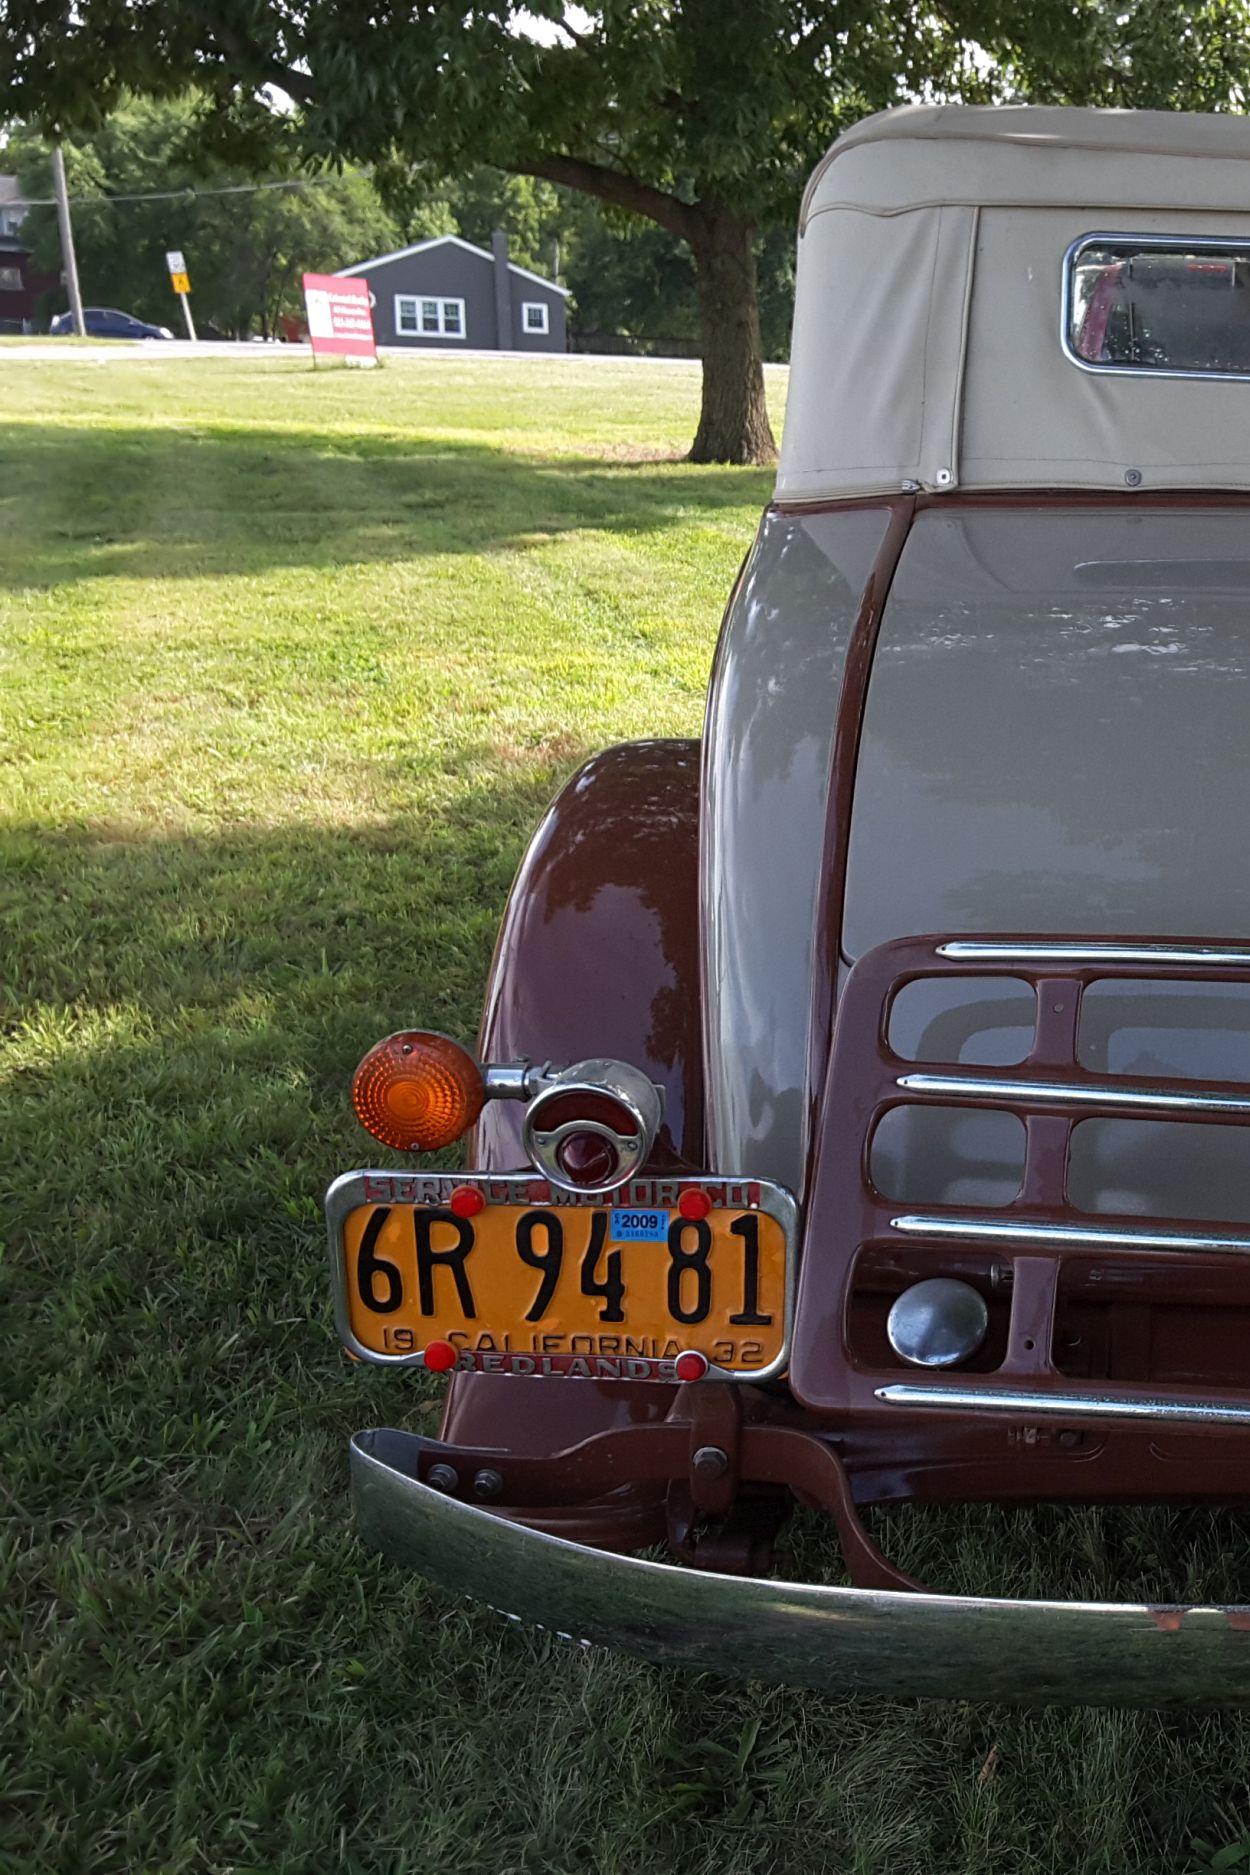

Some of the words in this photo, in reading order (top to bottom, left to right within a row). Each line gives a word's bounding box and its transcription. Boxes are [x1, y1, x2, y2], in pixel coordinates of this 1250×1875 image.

[366, 1178, 529, 1205] SERVCE
[621, 1214, 658, 1229] 2009
[383, 1328, 414, 1350] 19
[448, 1331, 682, 1358] CALIFORNIA
[709, 1341, 762, 1363] 32
[455, 1354, 679, 1380] REDLANDS
